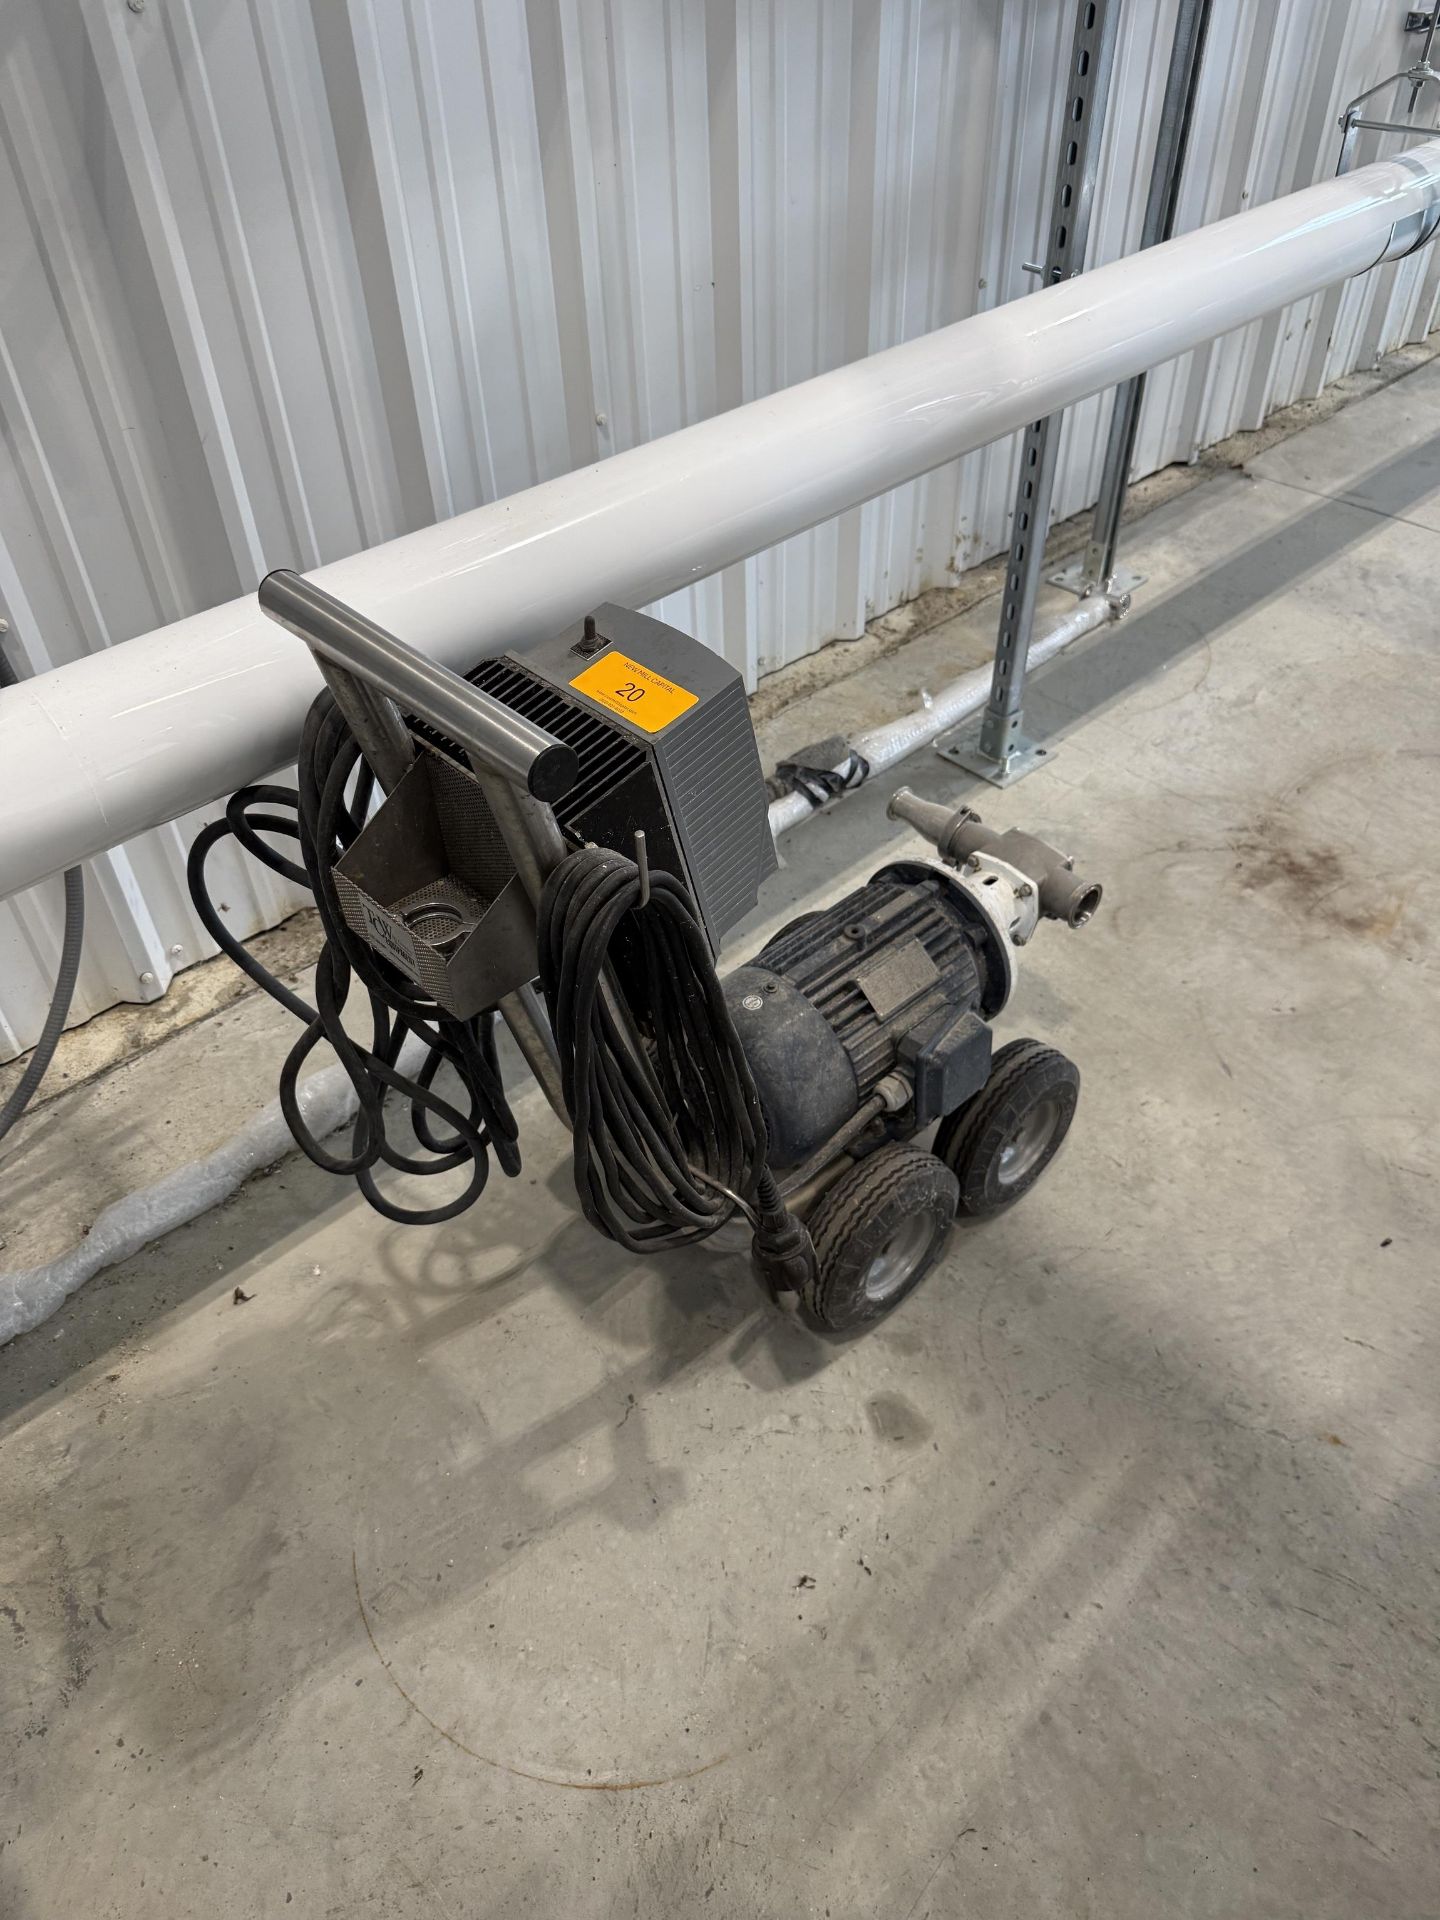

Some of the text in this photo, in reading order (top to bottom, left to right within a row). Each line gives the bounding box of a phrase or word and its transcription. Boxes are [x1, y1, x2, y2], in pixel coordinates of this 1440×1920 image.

[623, 662, 676, 694] NEW MILL CAPITAL
[615, 682, 645, 702] 20
